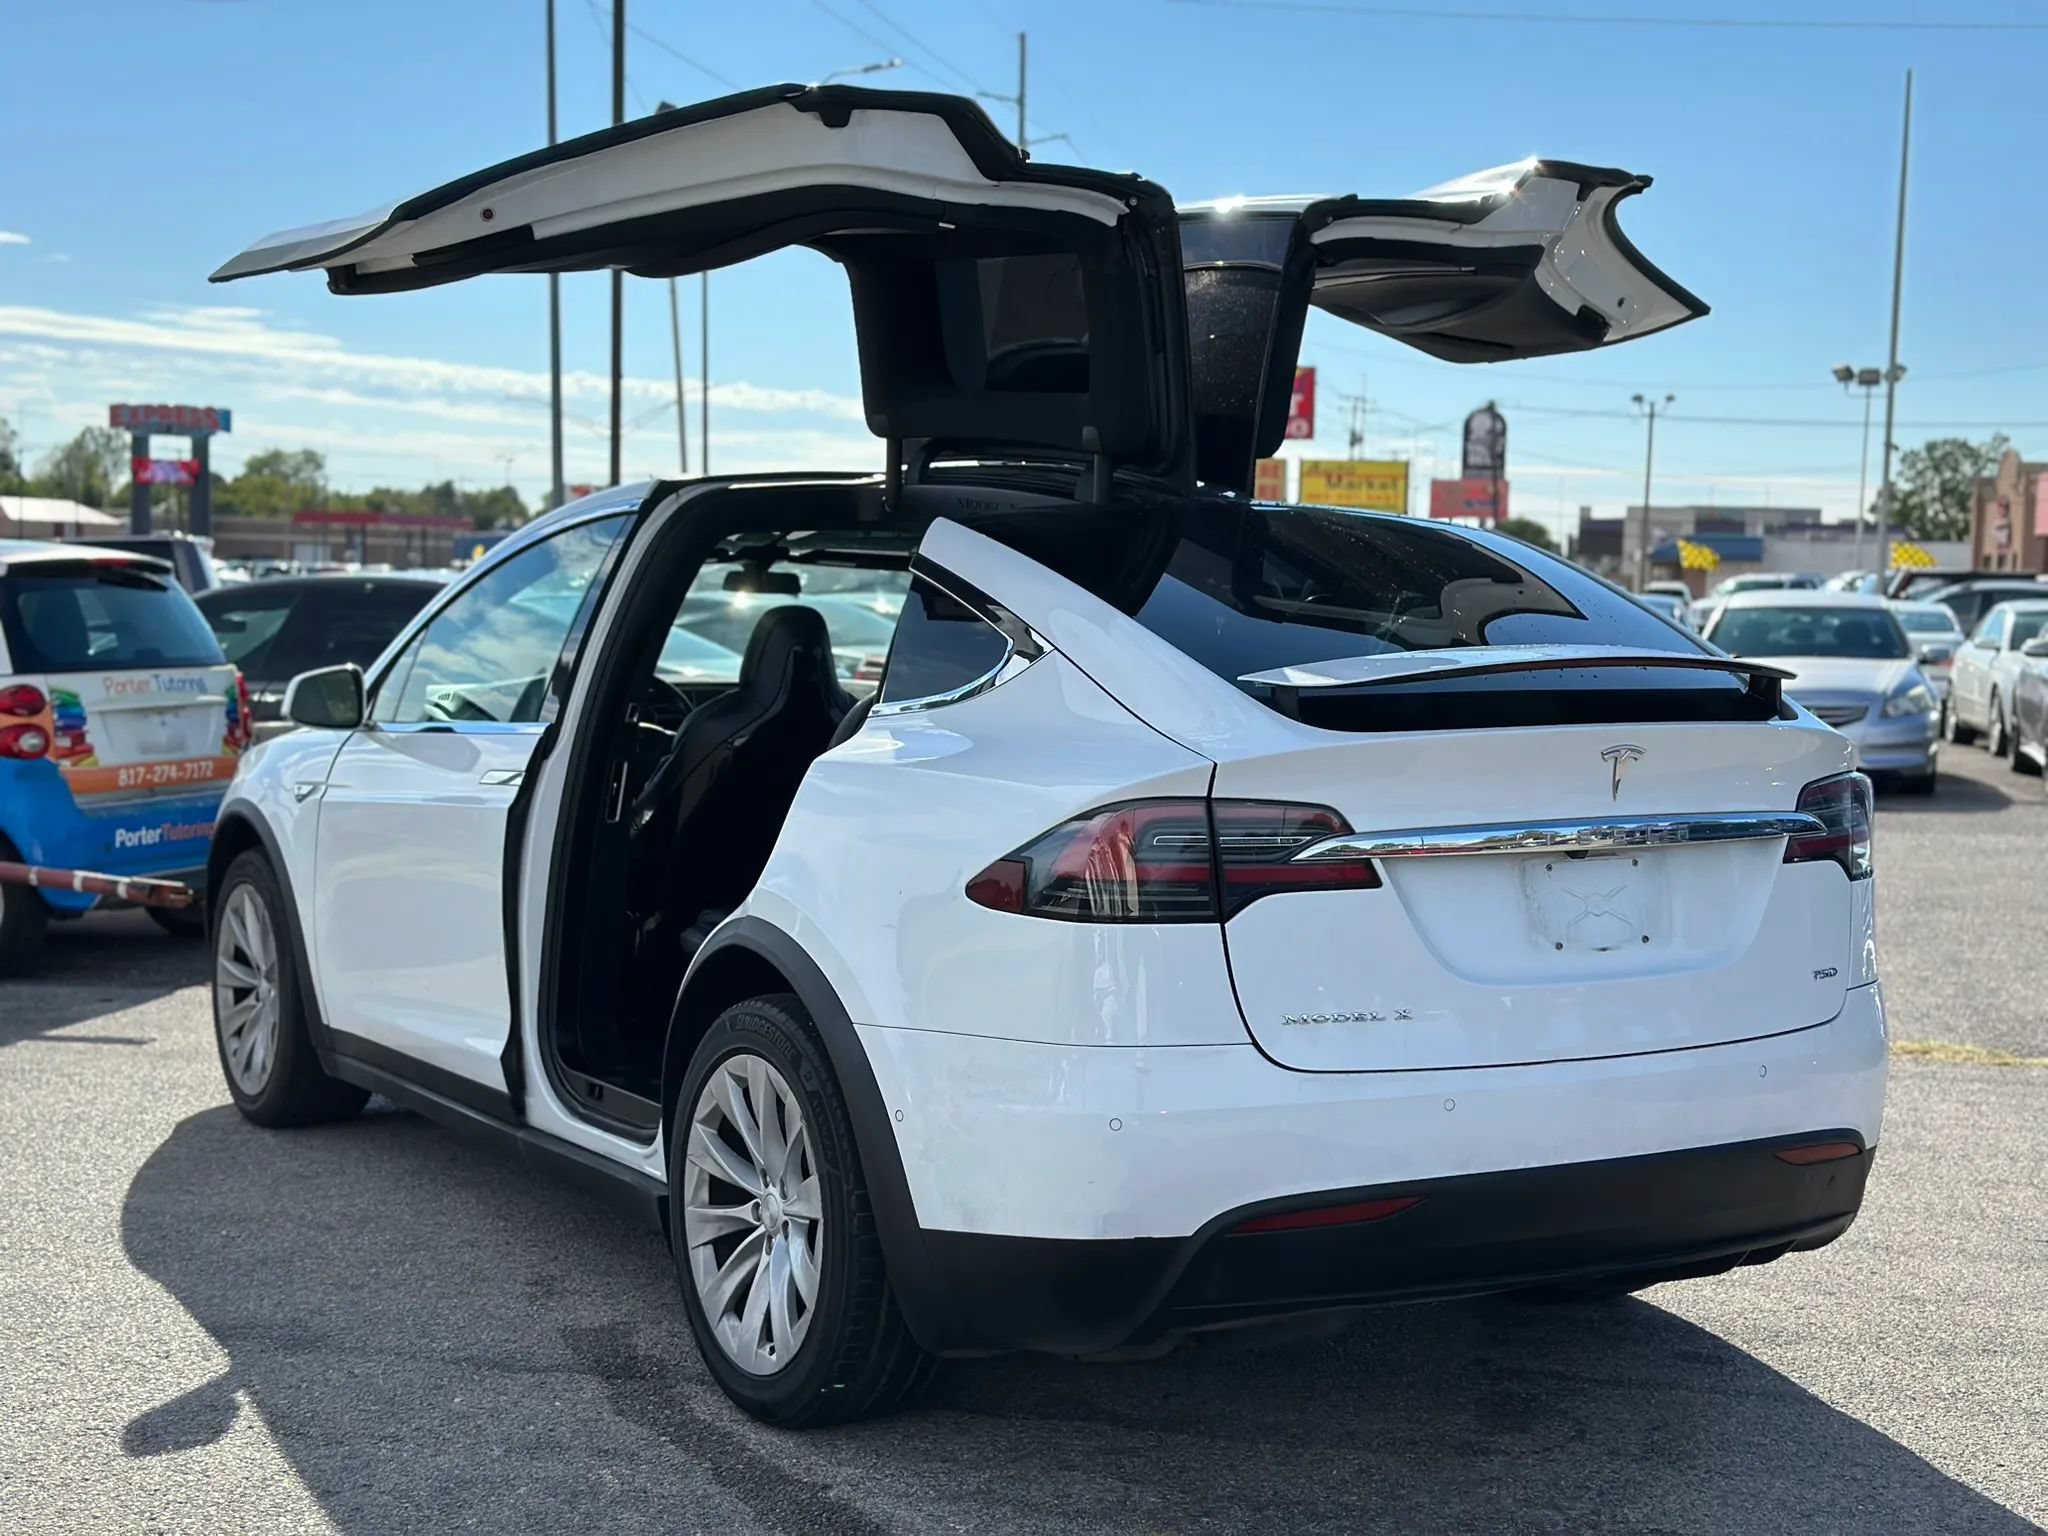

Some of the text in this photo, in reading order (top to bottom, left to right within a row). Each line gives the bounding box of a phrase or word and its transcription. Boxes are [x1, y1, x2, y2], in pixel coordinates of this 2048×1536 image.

[109, 404, 219, 431] EXPRESS
[103, 674, 208, 695] Porter Tutoring
[117, 760, 214, 788] 817-274-7172
[1813, 967, 1838, 980] 75D
[1281, 1008, 1413, 1026] MODEL X
